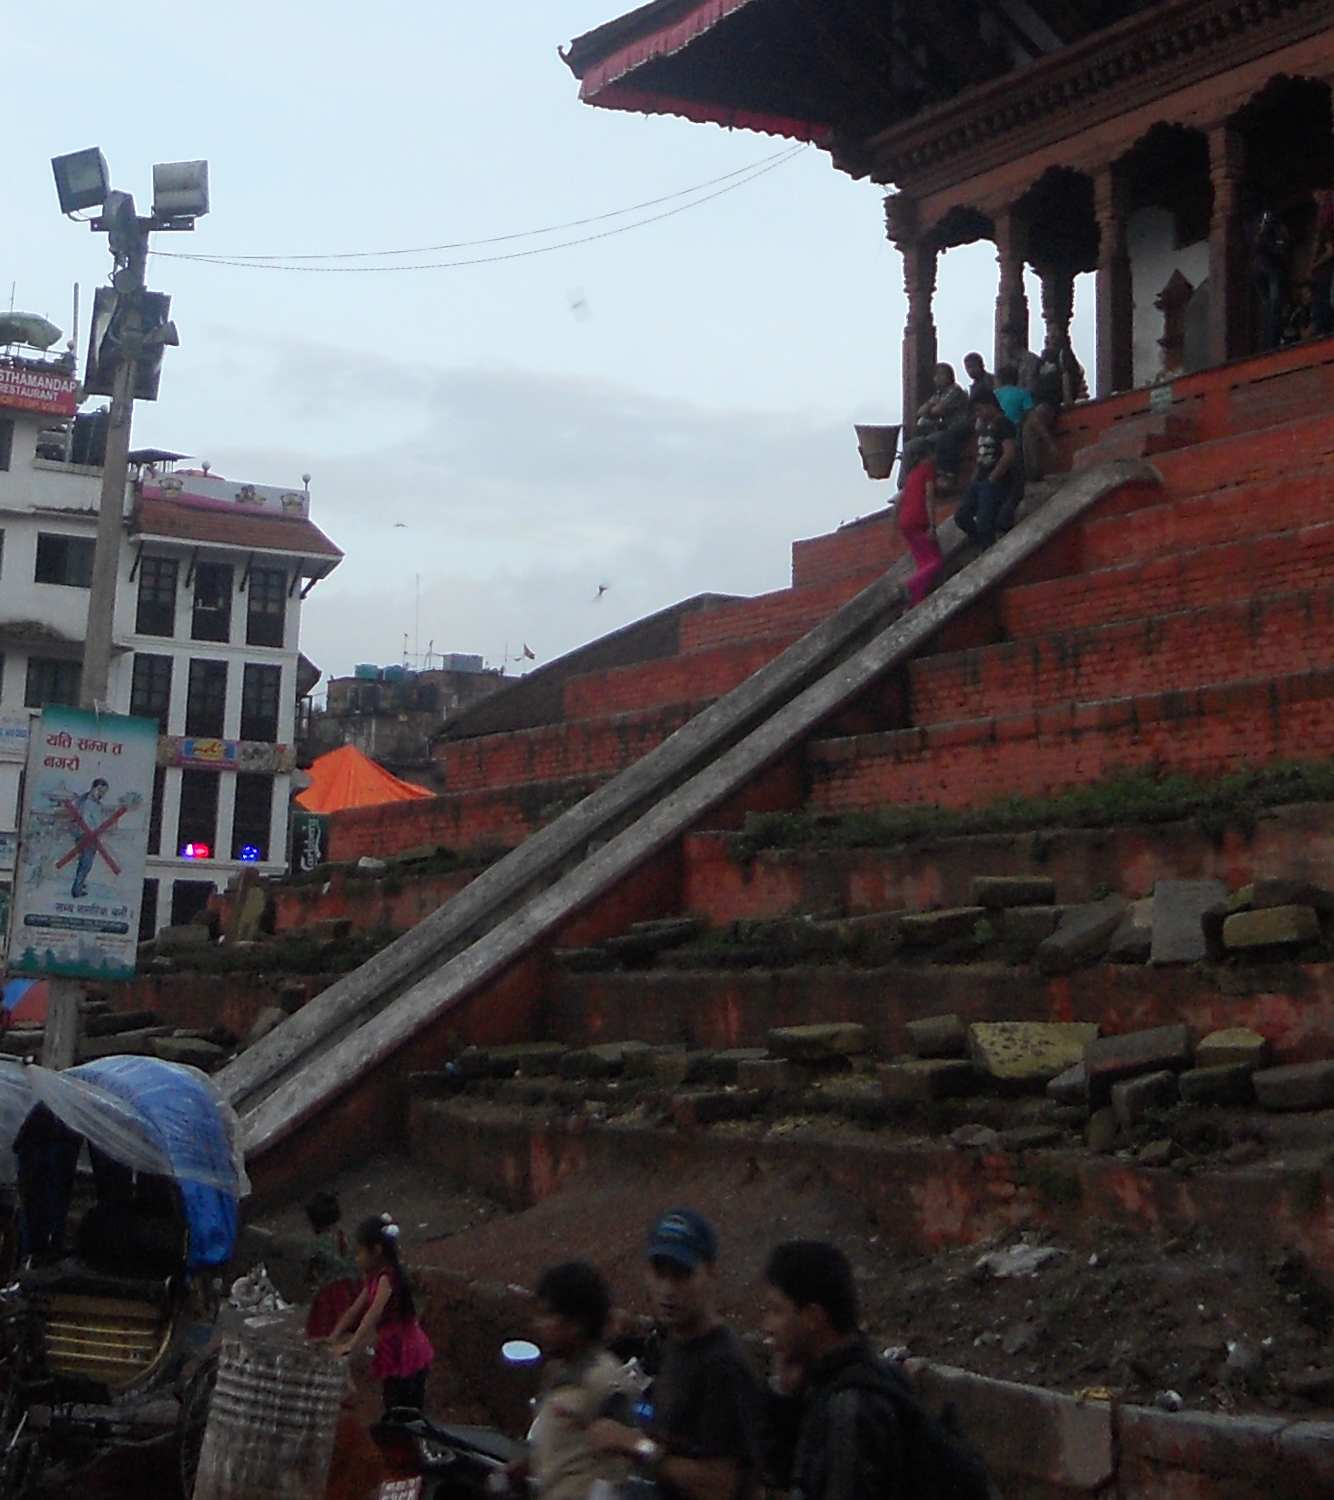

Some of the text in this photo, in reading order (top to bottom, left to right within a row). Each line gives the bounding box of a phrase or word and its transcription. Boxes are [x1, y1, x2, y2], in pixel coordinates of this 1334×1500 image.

[18, 397, 39, 409] TOP
[46, 731, 122, 755] यति सम्म त
